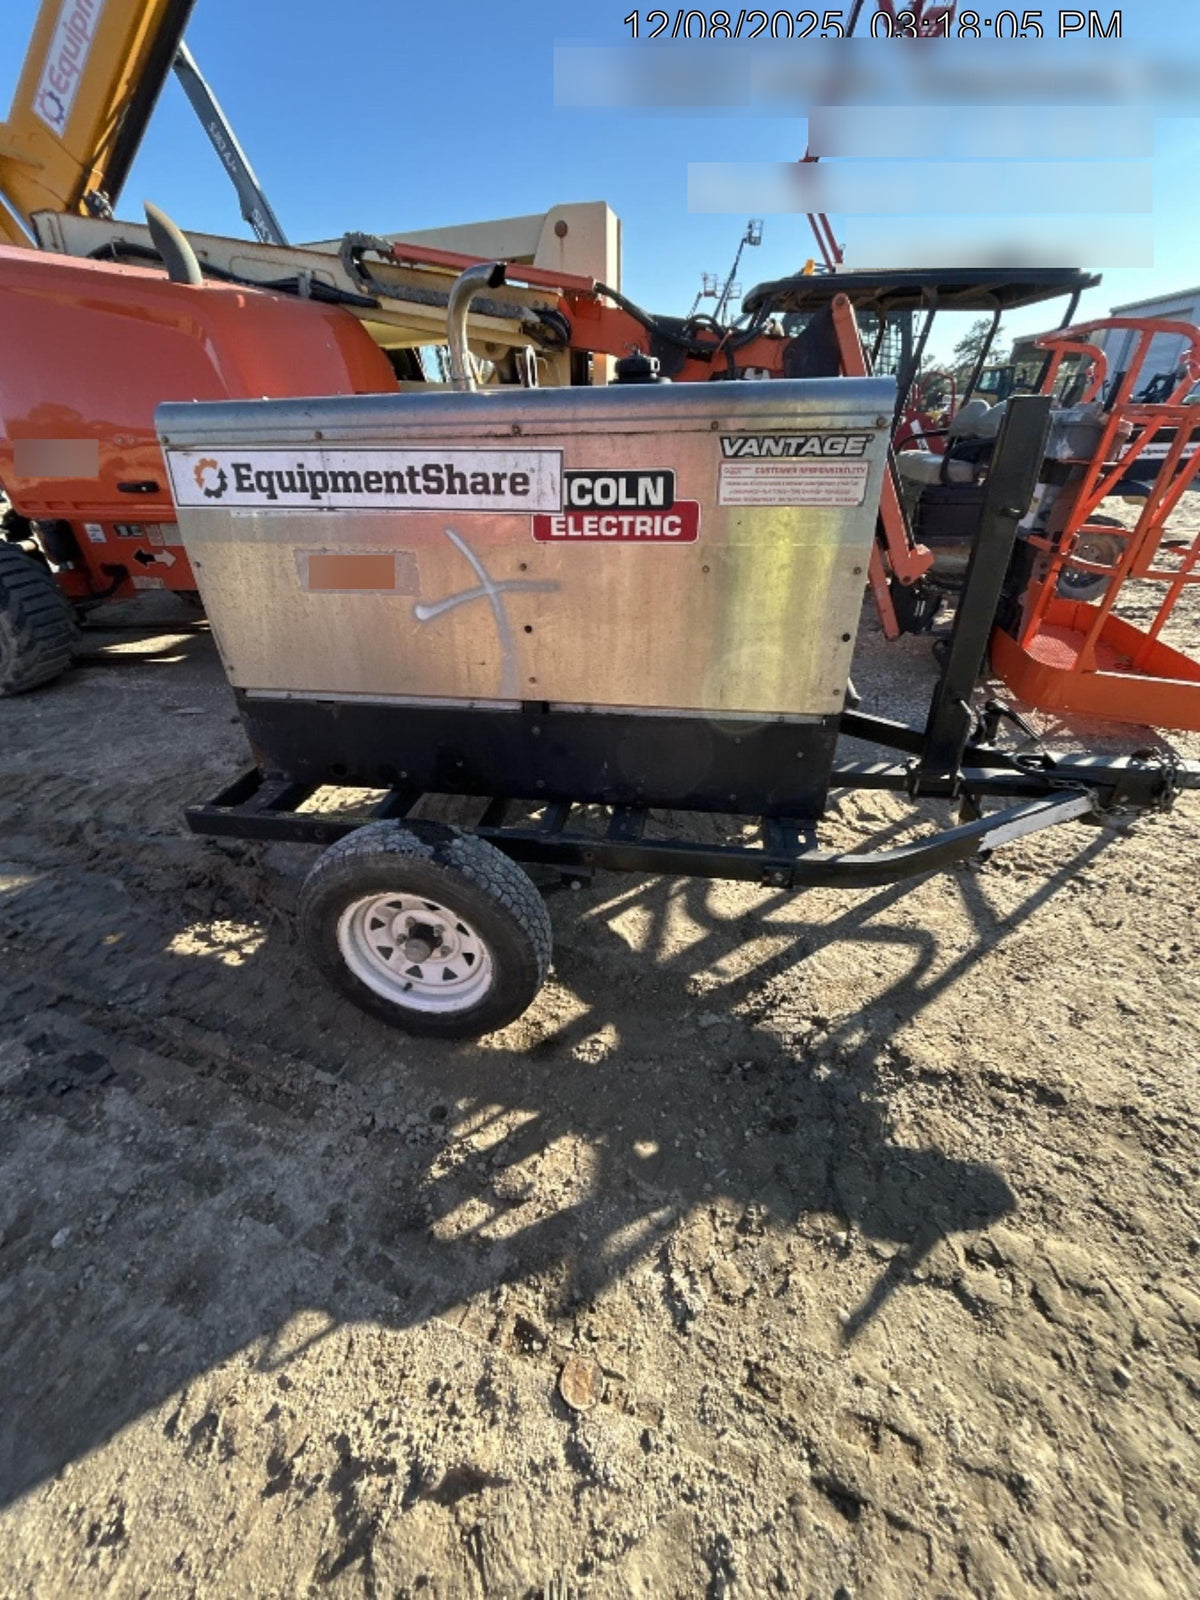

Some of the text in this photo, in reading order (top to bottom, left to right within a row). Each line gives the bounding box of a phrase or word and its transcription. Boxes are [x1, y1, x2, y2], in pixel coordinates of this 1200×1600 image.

[721, 435, 869, 457] VANTAGE
[230, 462, 531, 500] EquipmentShare
[564, 476, 665, 507] COLN
[550, 514, 682, 537] ELECTRIC
